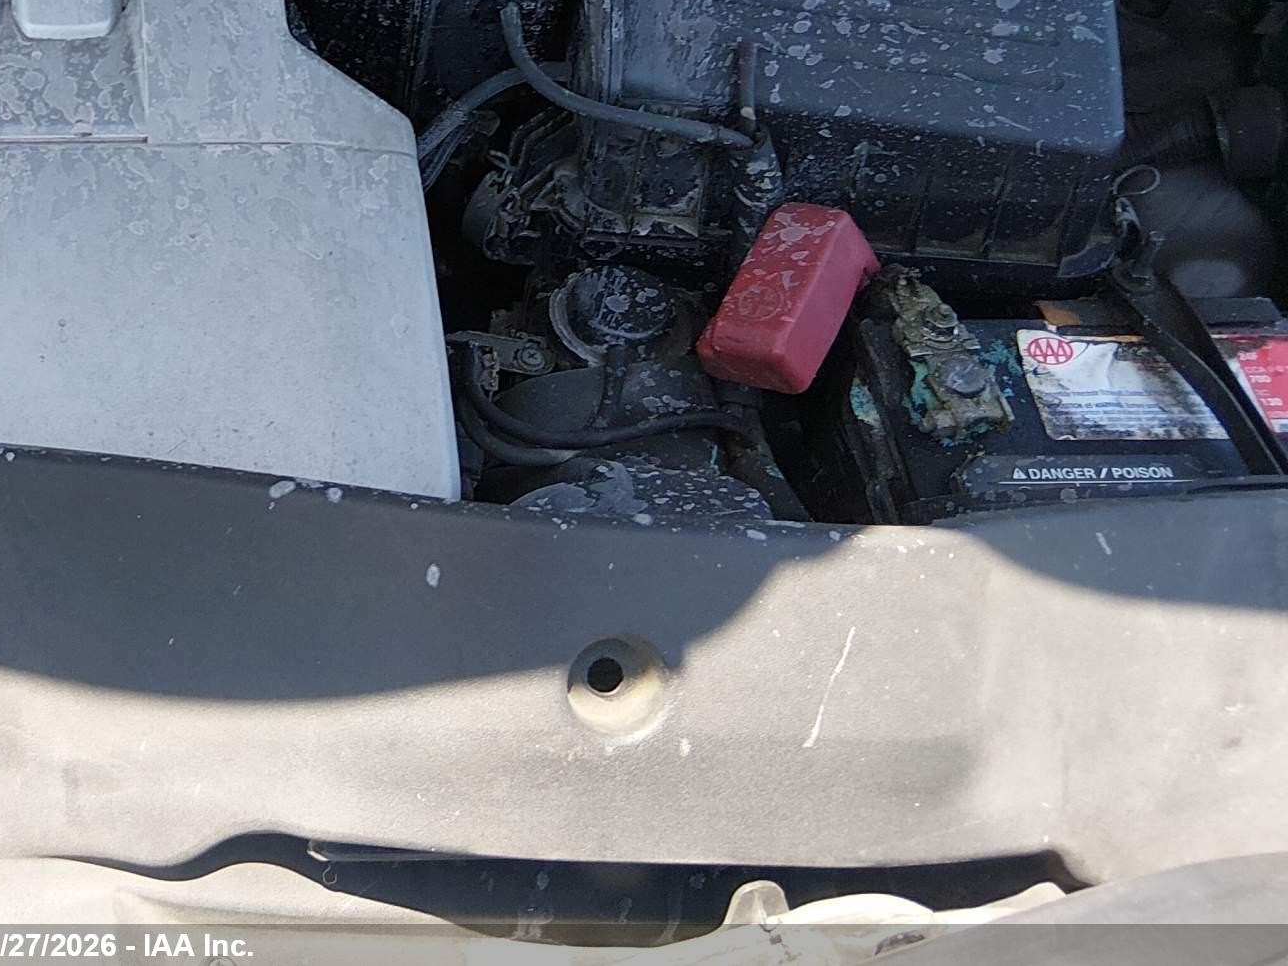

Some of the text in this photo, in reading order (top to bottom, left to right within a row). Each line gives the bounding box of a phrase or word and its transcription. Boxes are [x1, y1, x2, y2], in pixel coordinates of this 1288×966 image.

[1031, 338, 1071, 364] AAA
[1028, 467, 1097, 480] DANGER
[1112, 466, 1174, 479] POISON
